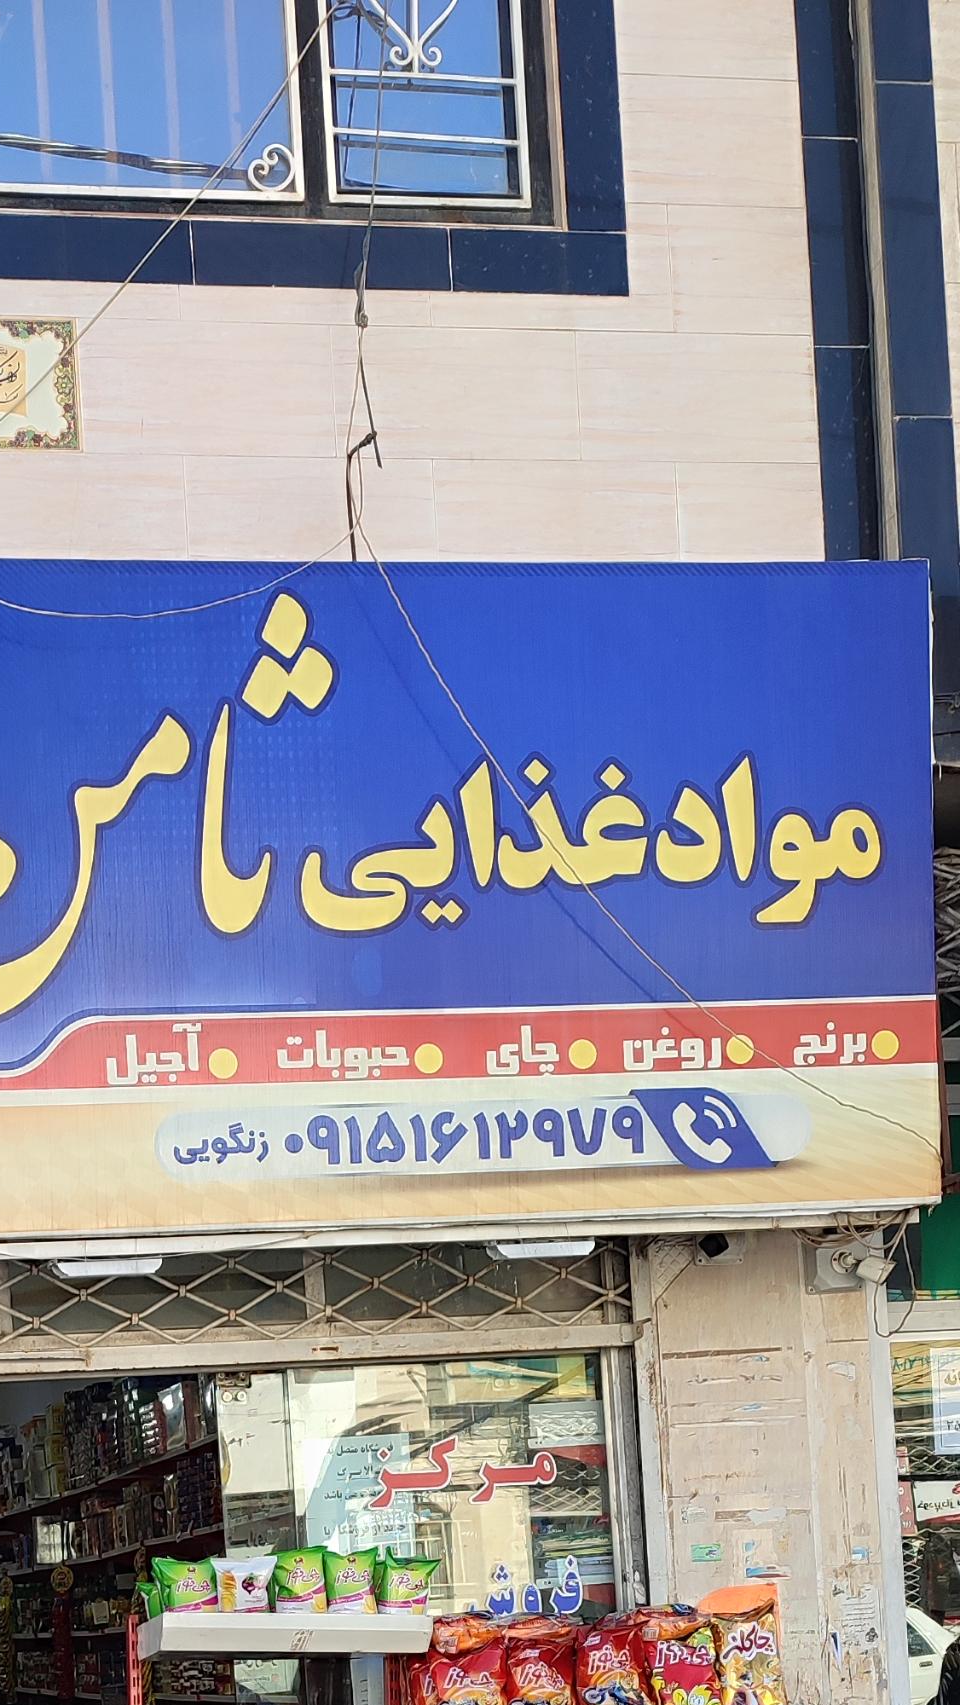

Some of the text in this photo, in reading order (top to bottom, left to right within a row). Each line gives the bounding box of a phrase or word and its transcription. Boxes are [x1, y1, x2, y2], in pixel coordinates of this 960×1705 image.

[300, 754, 652, 931] غذایی
[655, 752, 883, 927] مواد
[106, 1023, 202, 1085] آجیل
[276, 1030, 410, 1079] حبوبات
[486, 1025, 560, 1075] چای
[622, 1027, 722, 1071] روغن
[793, 1021, 867, 1066] برنج
[284, 1105, 645, 1165] ۰۹۱۵۱۶۱۲۹۷۹
[368, 1436, 558, 1509] مرکز
